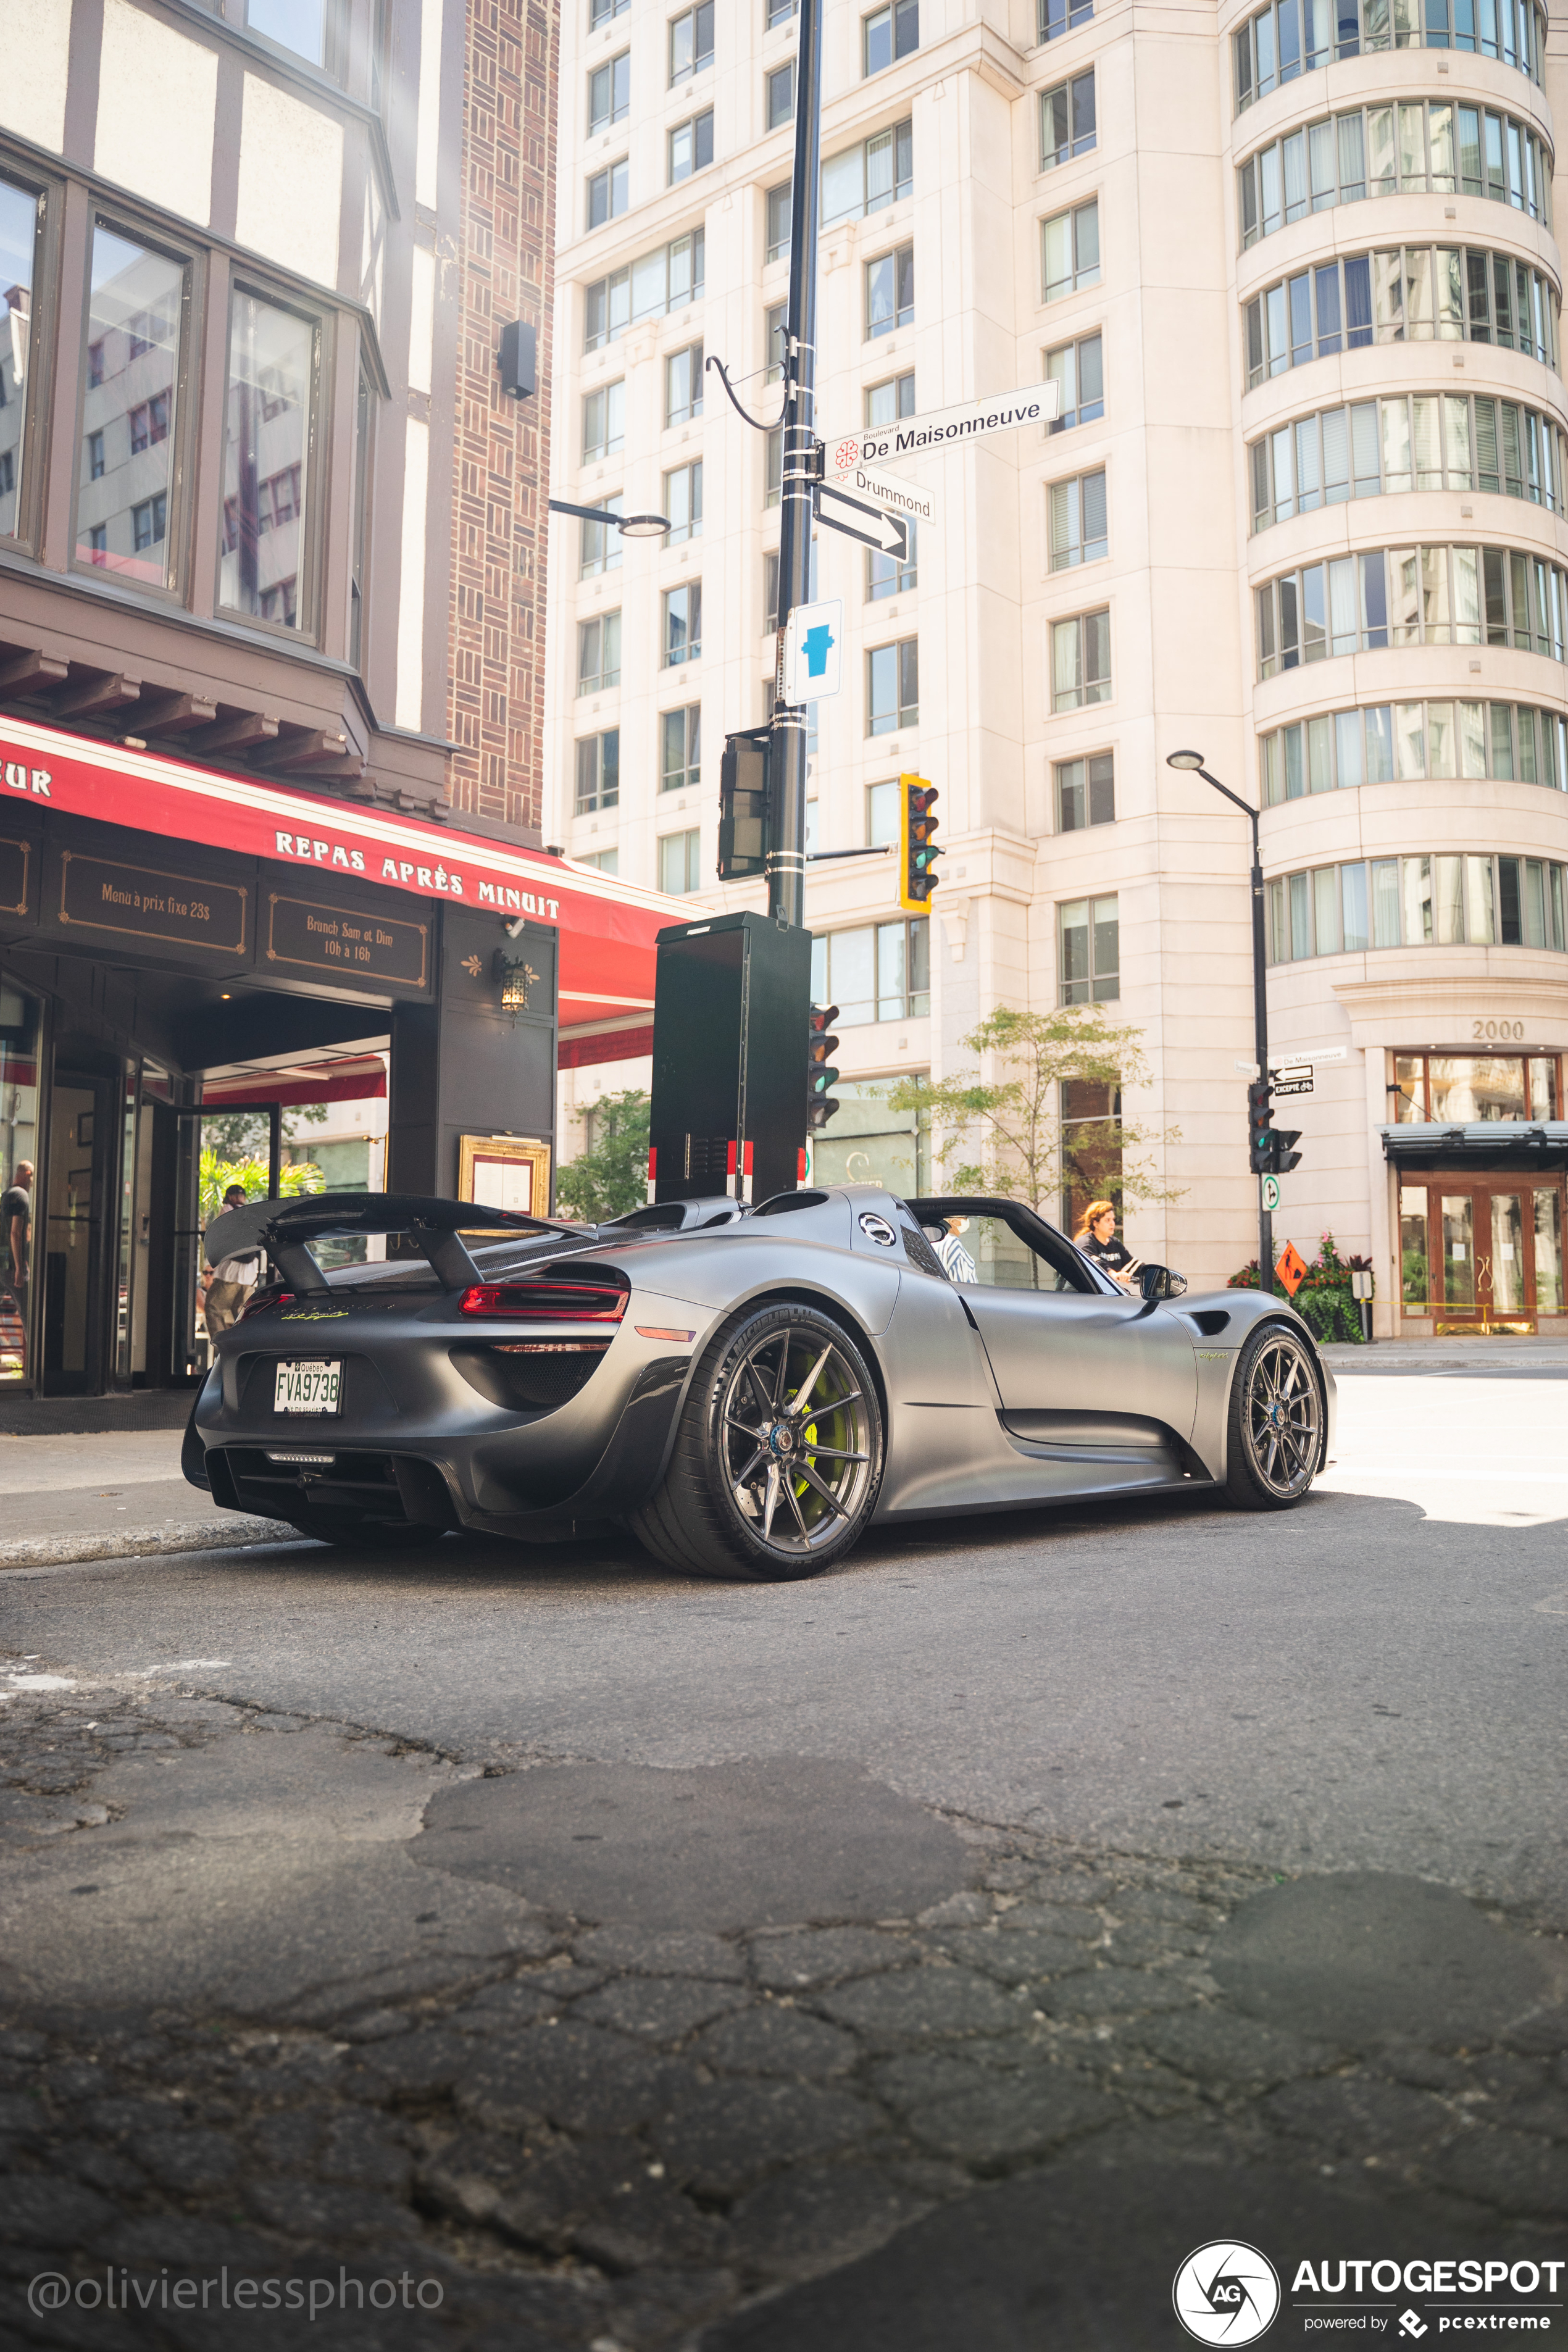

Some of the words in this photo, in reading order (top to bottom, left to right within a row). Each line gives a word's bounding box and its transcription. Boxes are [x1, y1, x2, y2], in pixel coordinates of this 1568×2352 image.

[863, 442, 888, 461] De
[896, 404, 1040, 452] Maisonneuve
[864, 425, 899, 441] Boulevard
[856, 471, 930, 517] Drummond
[0, 759, 52, 798] UR
[275, 831, 365, 871] REPAS
[382, 857, 463, 895] APRÈS
[478, 881, 560, 919] MINUIT
[102, 883, 131, 905] Menu
[134, 891, 140, 907] à
[143, 895, 165, 912] prix
[168, 897, 187, 915] fixe
[190, 902, 210, 921] 23$
[307, 915, 338, 936] Brunch
[342, 922, 361, 941] Sam
[364, 930, 373, 942] et
[376, 929, 393, 948] Dim
[325, 940, 341, 957] 10h
[344, 944, 350, 957] à
[355, 946, 370, 963] 16h
[1472, 1020, 1524, 1040] 2000
[1296, 1053, 1341, 1063] Maisonneuve
[732, 1308, 791, 1357] MICHELIN
[301, 1363, 323, 1372] Québec
[277, 1373, 339, 1402] FVA9738
